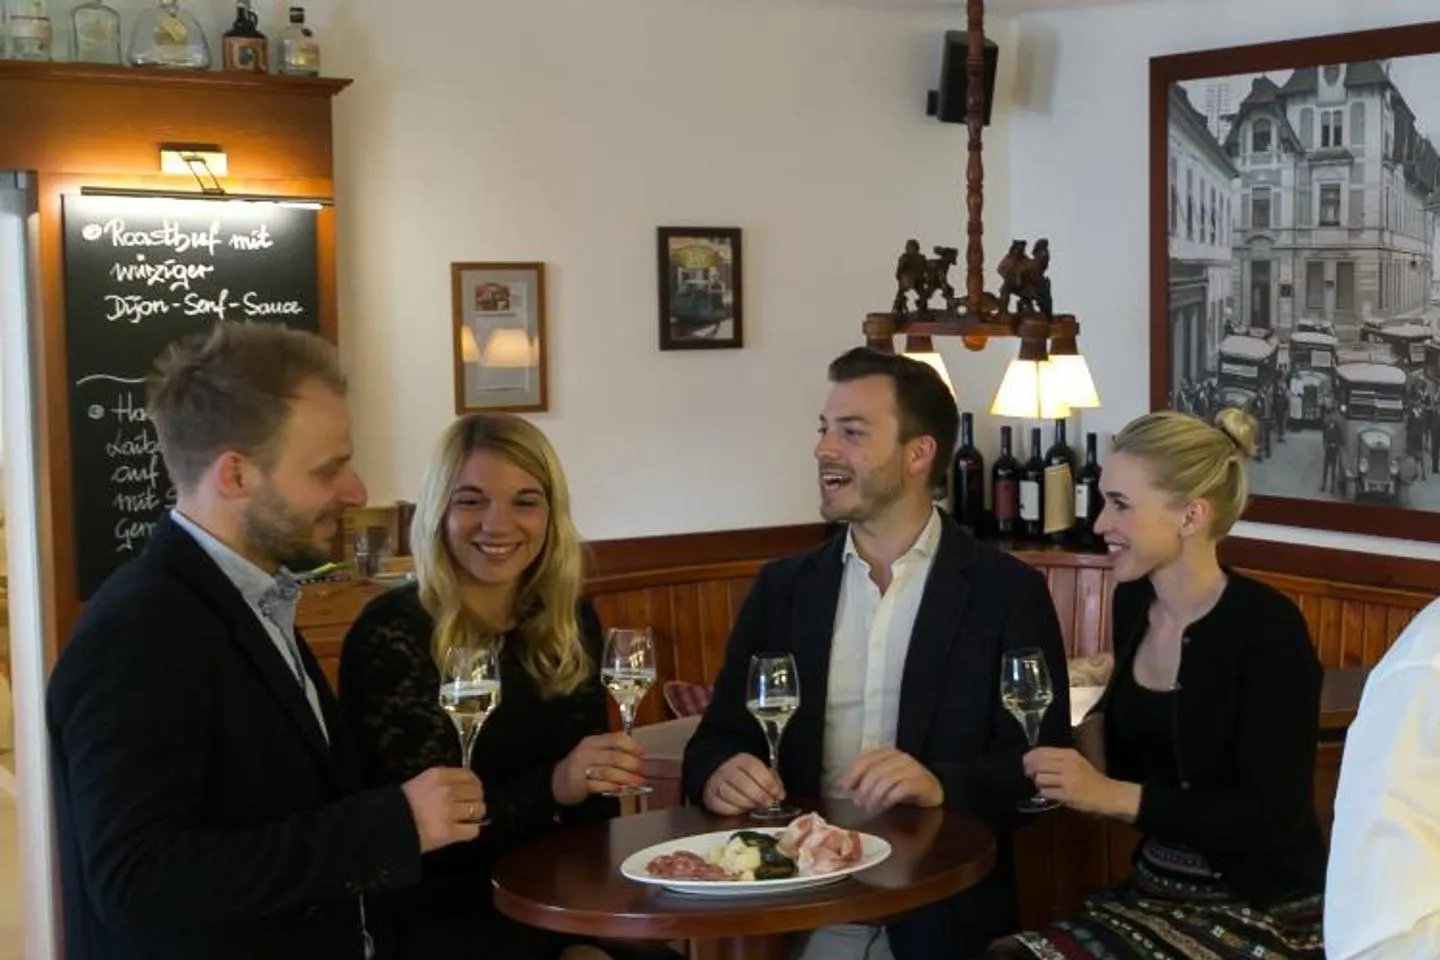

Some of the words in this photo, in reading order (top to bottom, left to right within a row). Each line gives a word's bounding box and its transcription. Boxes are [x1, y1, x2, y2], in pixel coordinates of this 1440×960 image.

[229, 224, 274, 250] mit
[112, 454, 160, 488] auf
[114, 487, 160, 512] mit
